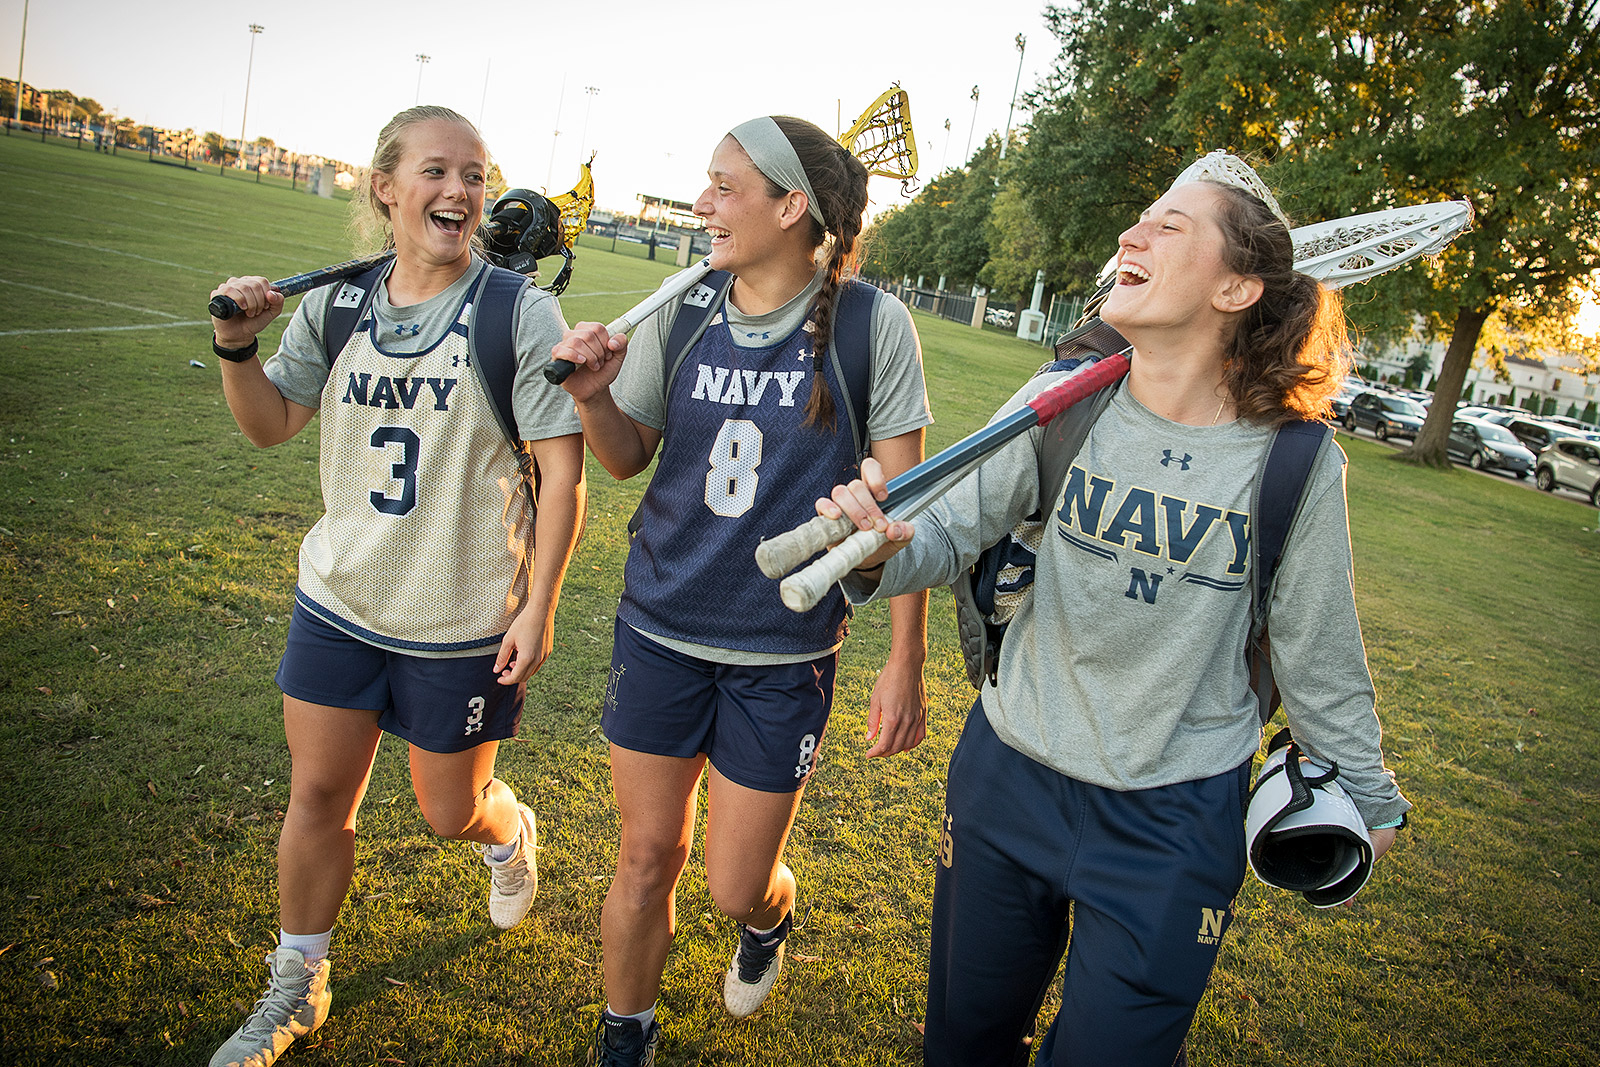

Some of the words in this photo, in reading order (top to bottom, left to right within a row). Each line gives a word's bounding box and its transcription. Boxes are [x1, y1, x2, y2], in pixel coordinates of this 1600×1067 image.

[342, 372, 458, 411] NAVY
[691, 363, 805, 407] NAVY
[370, 425, 421, 517] 3
[704, 418, 763, 518] 8
[1056, 464, 1251, 576] NAVY
[1125, 567, 1164, 605] N
[466, 695, 486, 726] 3
[799, 733, 816, 766] 8
[1197, 934, 1220, 946] NAVY
[1198, 907, 1226, 938] N
